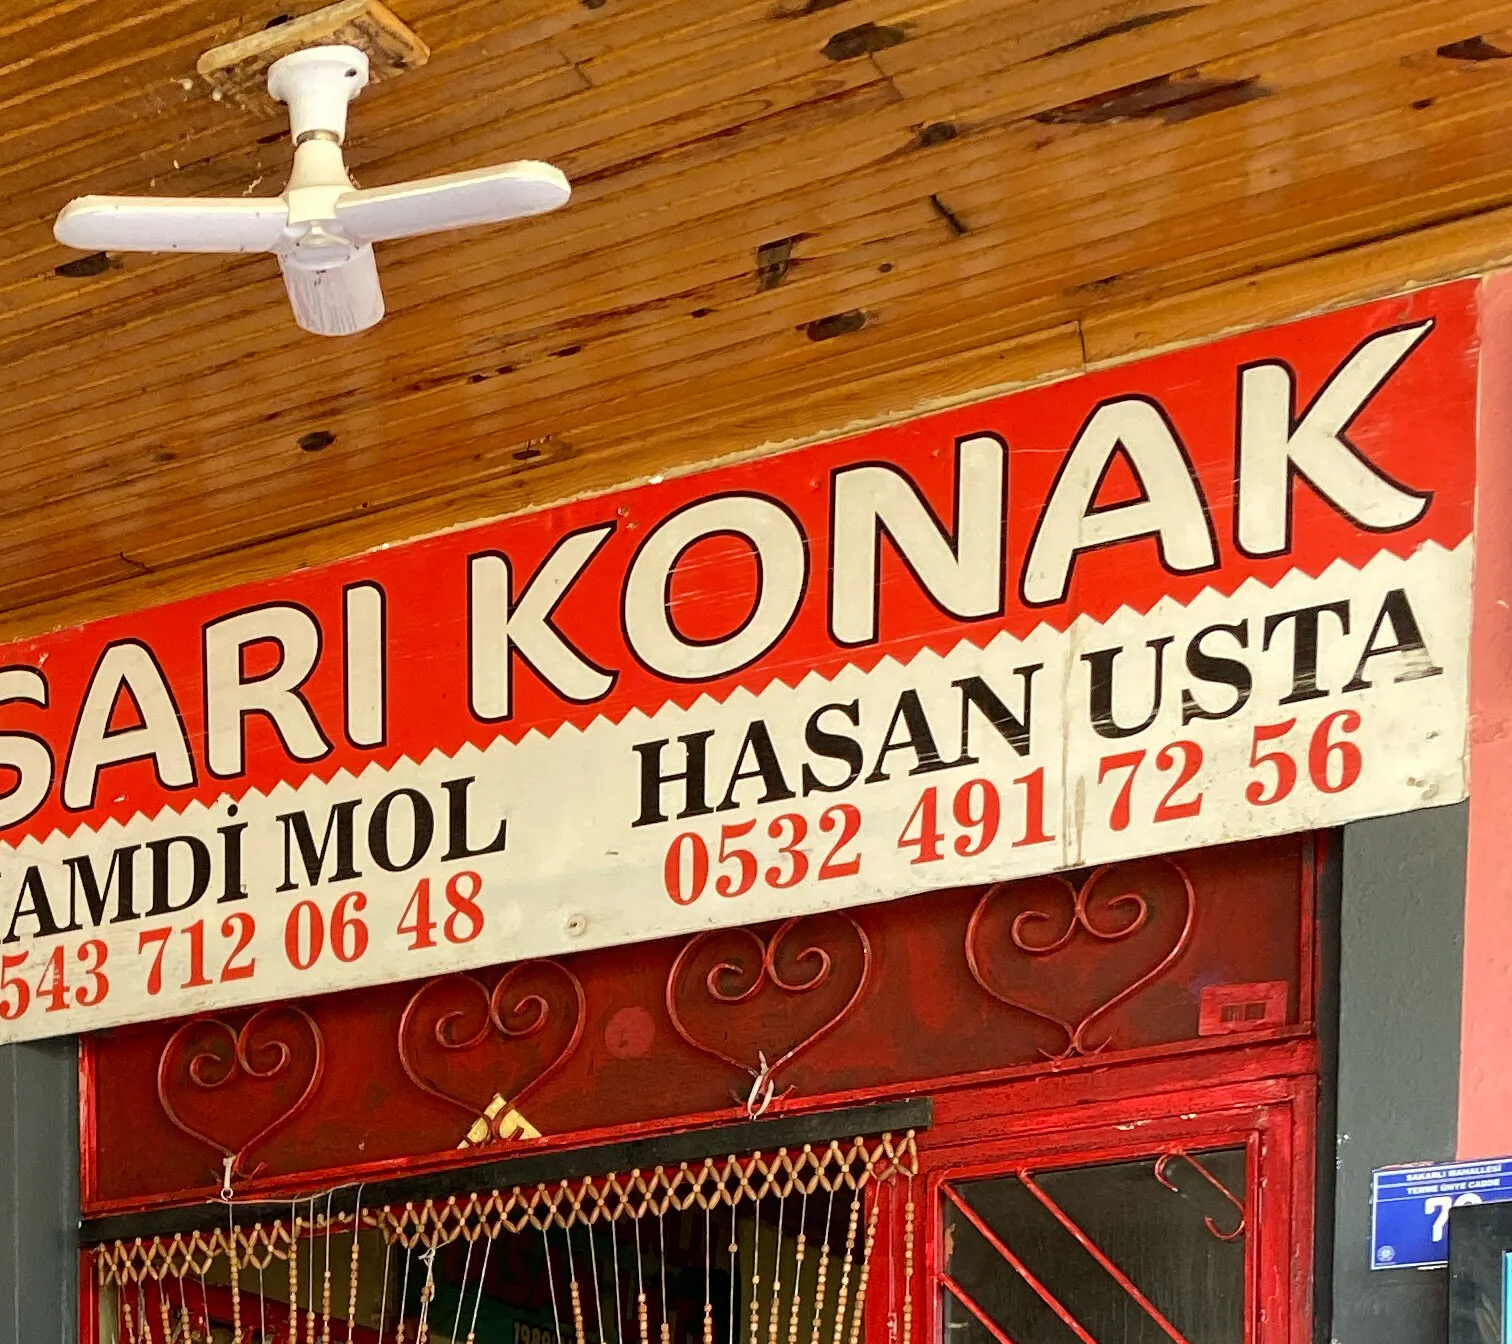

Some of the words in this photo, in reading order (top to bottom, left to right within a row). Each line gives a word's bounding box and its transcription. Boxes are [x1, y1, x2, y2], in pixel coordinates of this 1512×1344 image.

[469, 317, 1436, 722] KONAK
[631, 662, 1045, 828] HASAN
[1081, 588, 1443, 738] USTA
[276, 777, 507, 893] MOL
[663, 803, 862, 906] 0532
[897, 766, 1056, 864] 491
[1098, 740, 1204, 832] 72
[1245, 710, 1363, 806] 56
[138, 911, 256, 996] 712
[284, 890, 370, 971] 06
[396, 870, 485, 950] 48
[1425, 1192, 1483, 1242] 7
